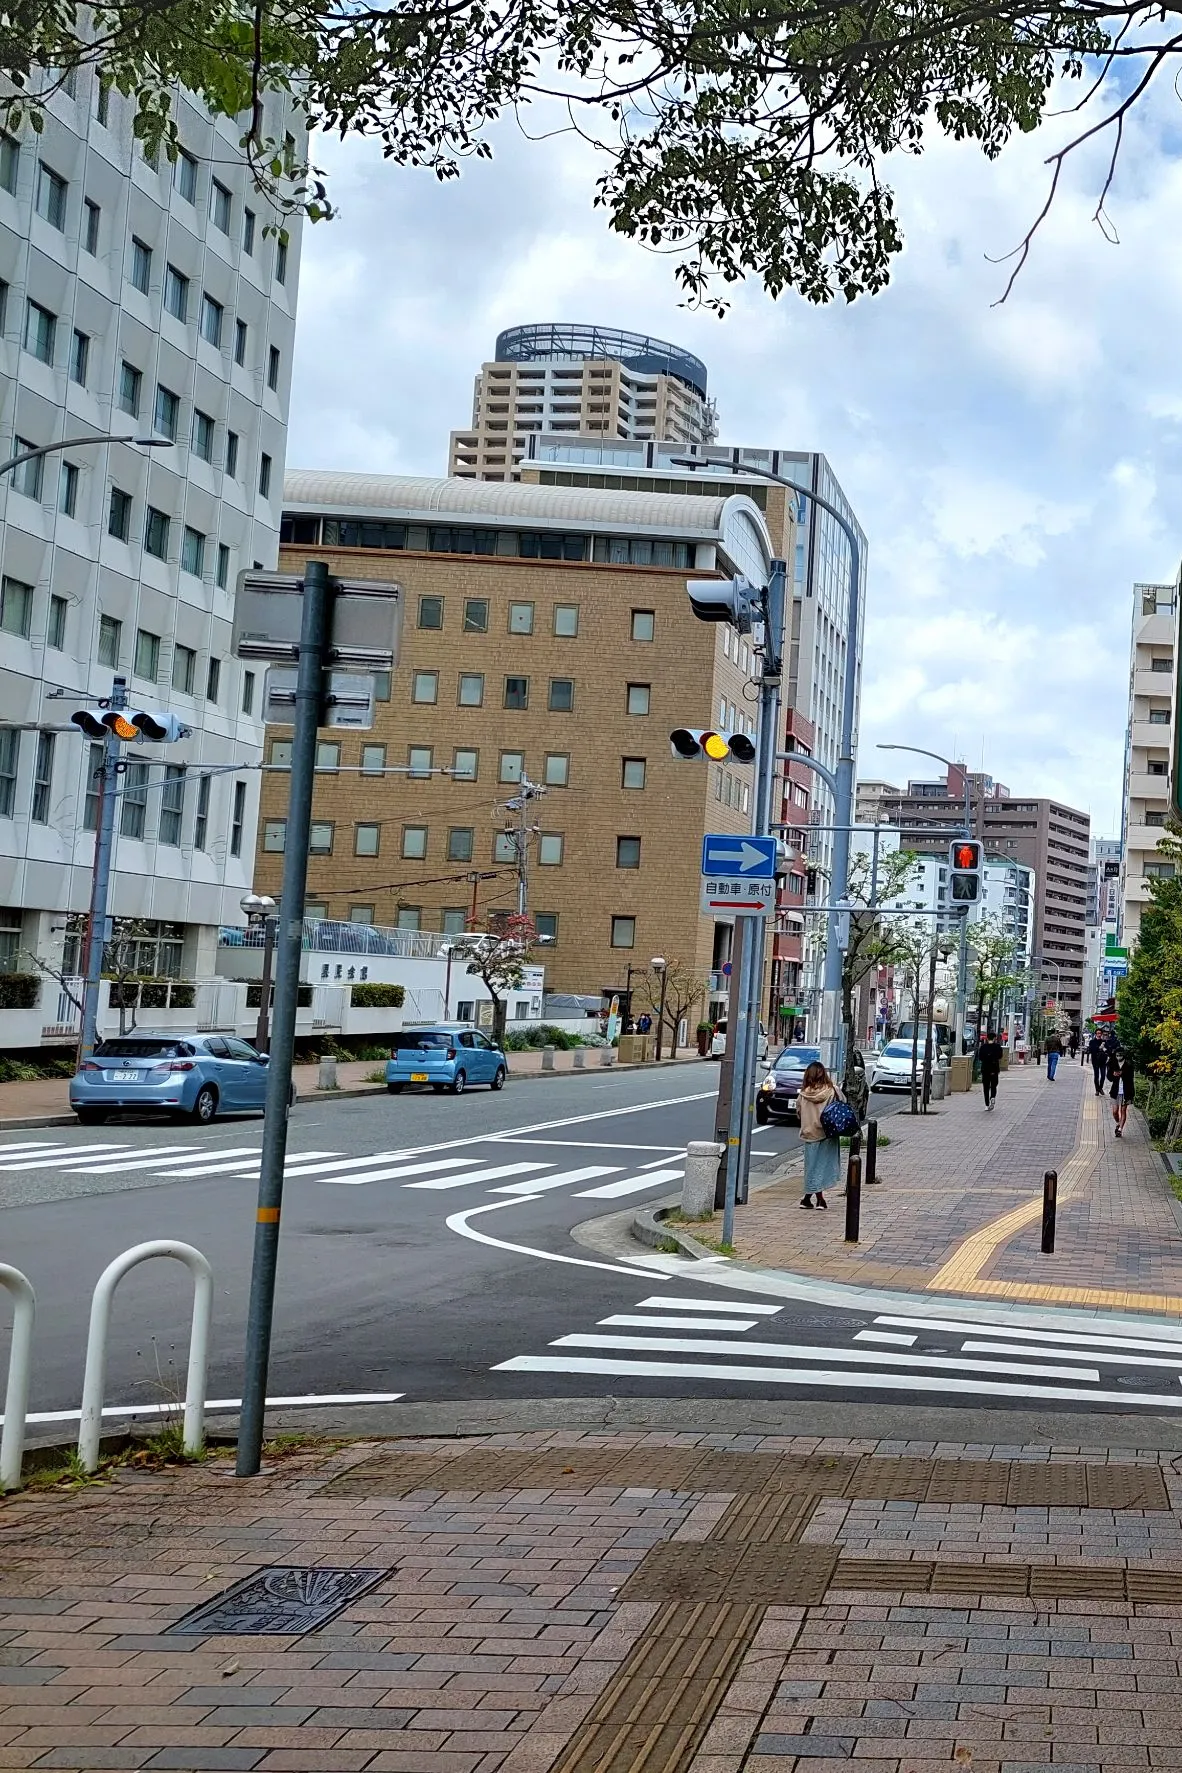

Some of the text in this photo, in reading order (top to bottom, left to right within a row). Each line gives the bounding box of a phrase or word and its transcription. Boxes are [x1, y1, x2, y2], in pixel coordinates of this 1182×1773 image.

[706, 881, 773, 897] 自動車・原付
